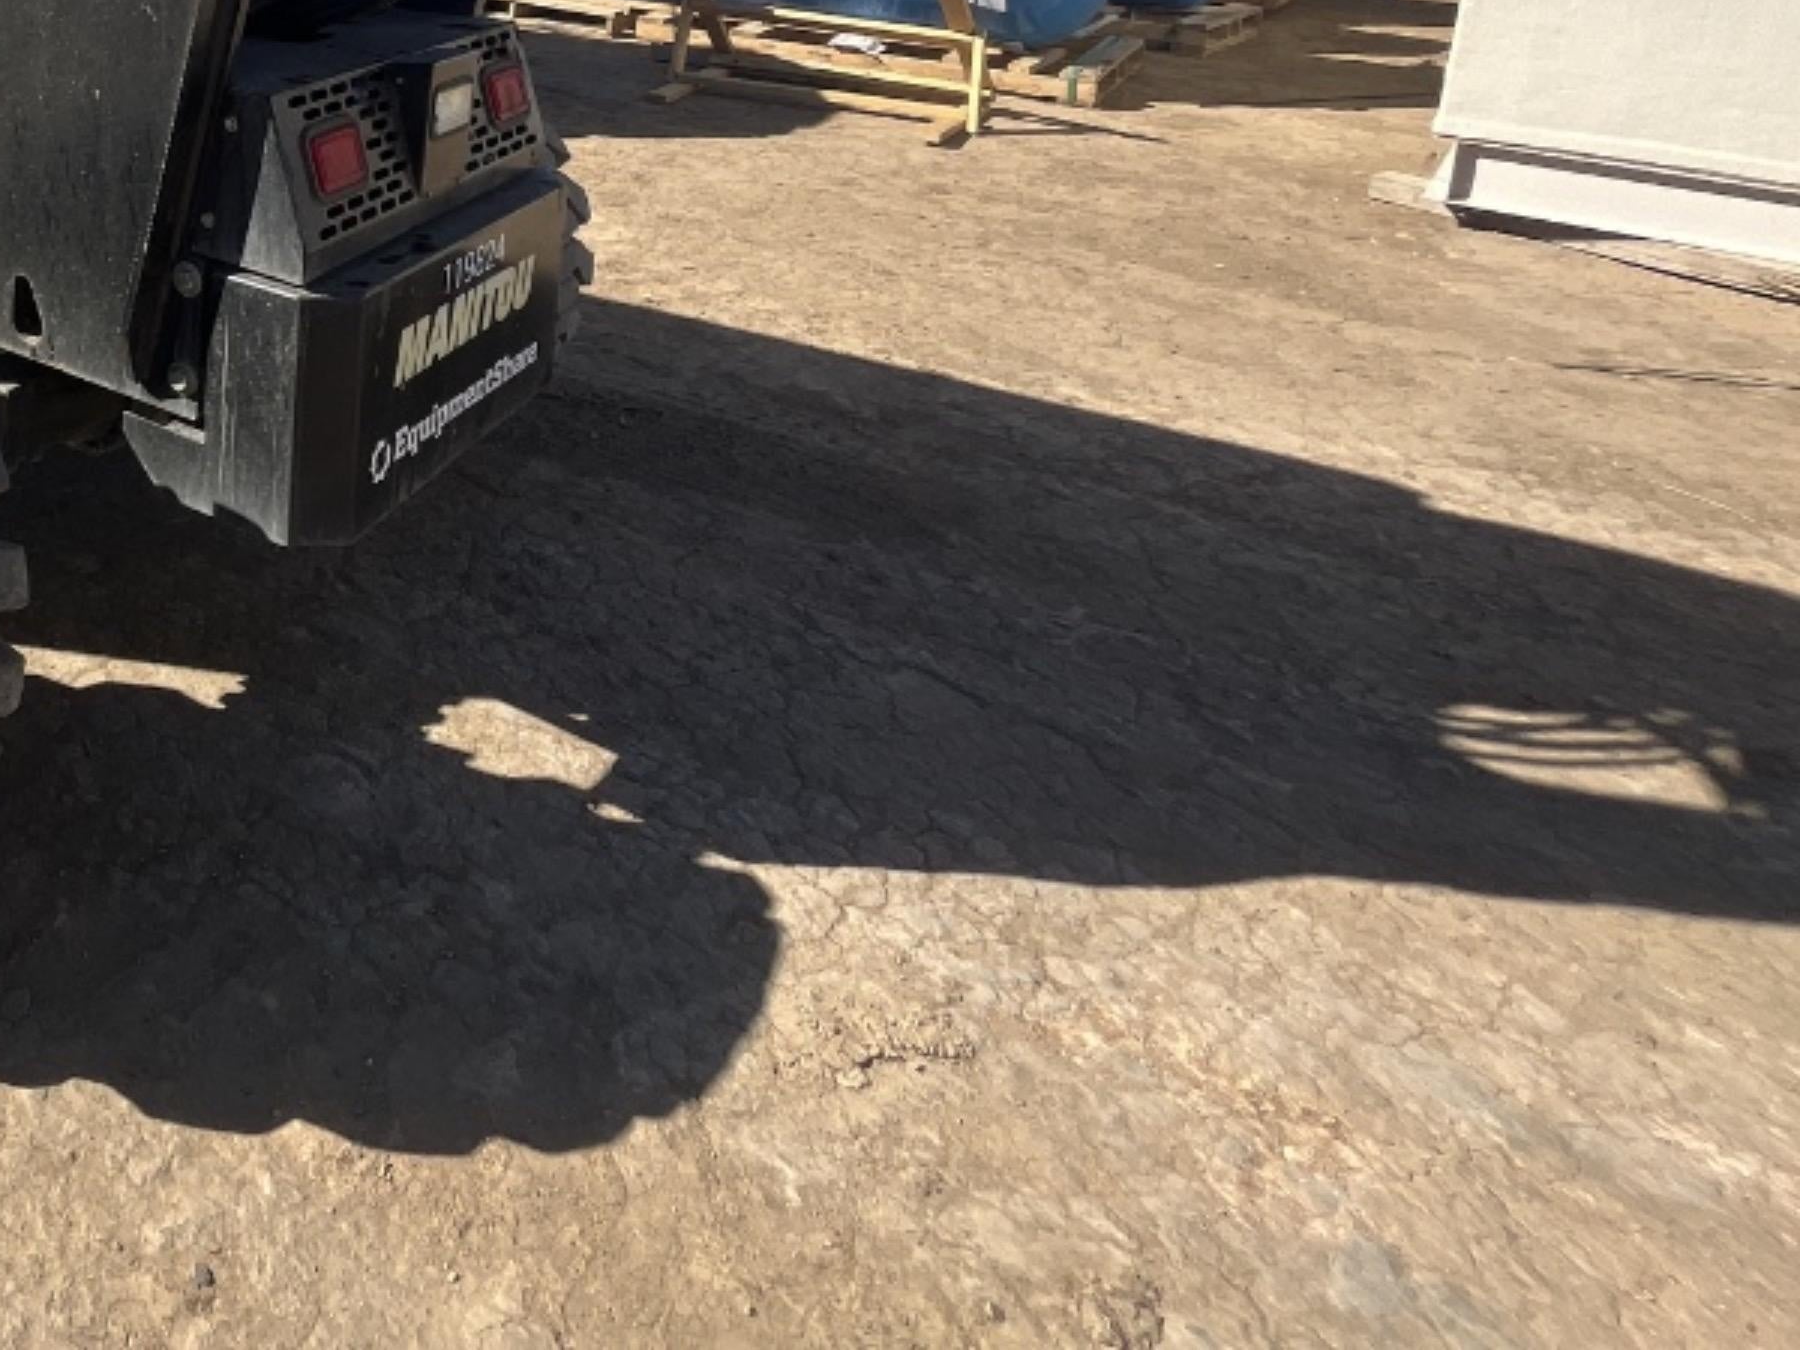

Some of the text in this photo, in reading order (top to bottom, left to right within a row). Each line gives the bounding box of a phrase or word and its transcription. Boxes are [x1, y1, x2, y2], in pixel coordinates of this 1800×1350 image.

[392, 254, 536, 389] MANITOU
[443, 233, 506, 294] 119824
[392, 341, 538, 463] EquipmentShare
